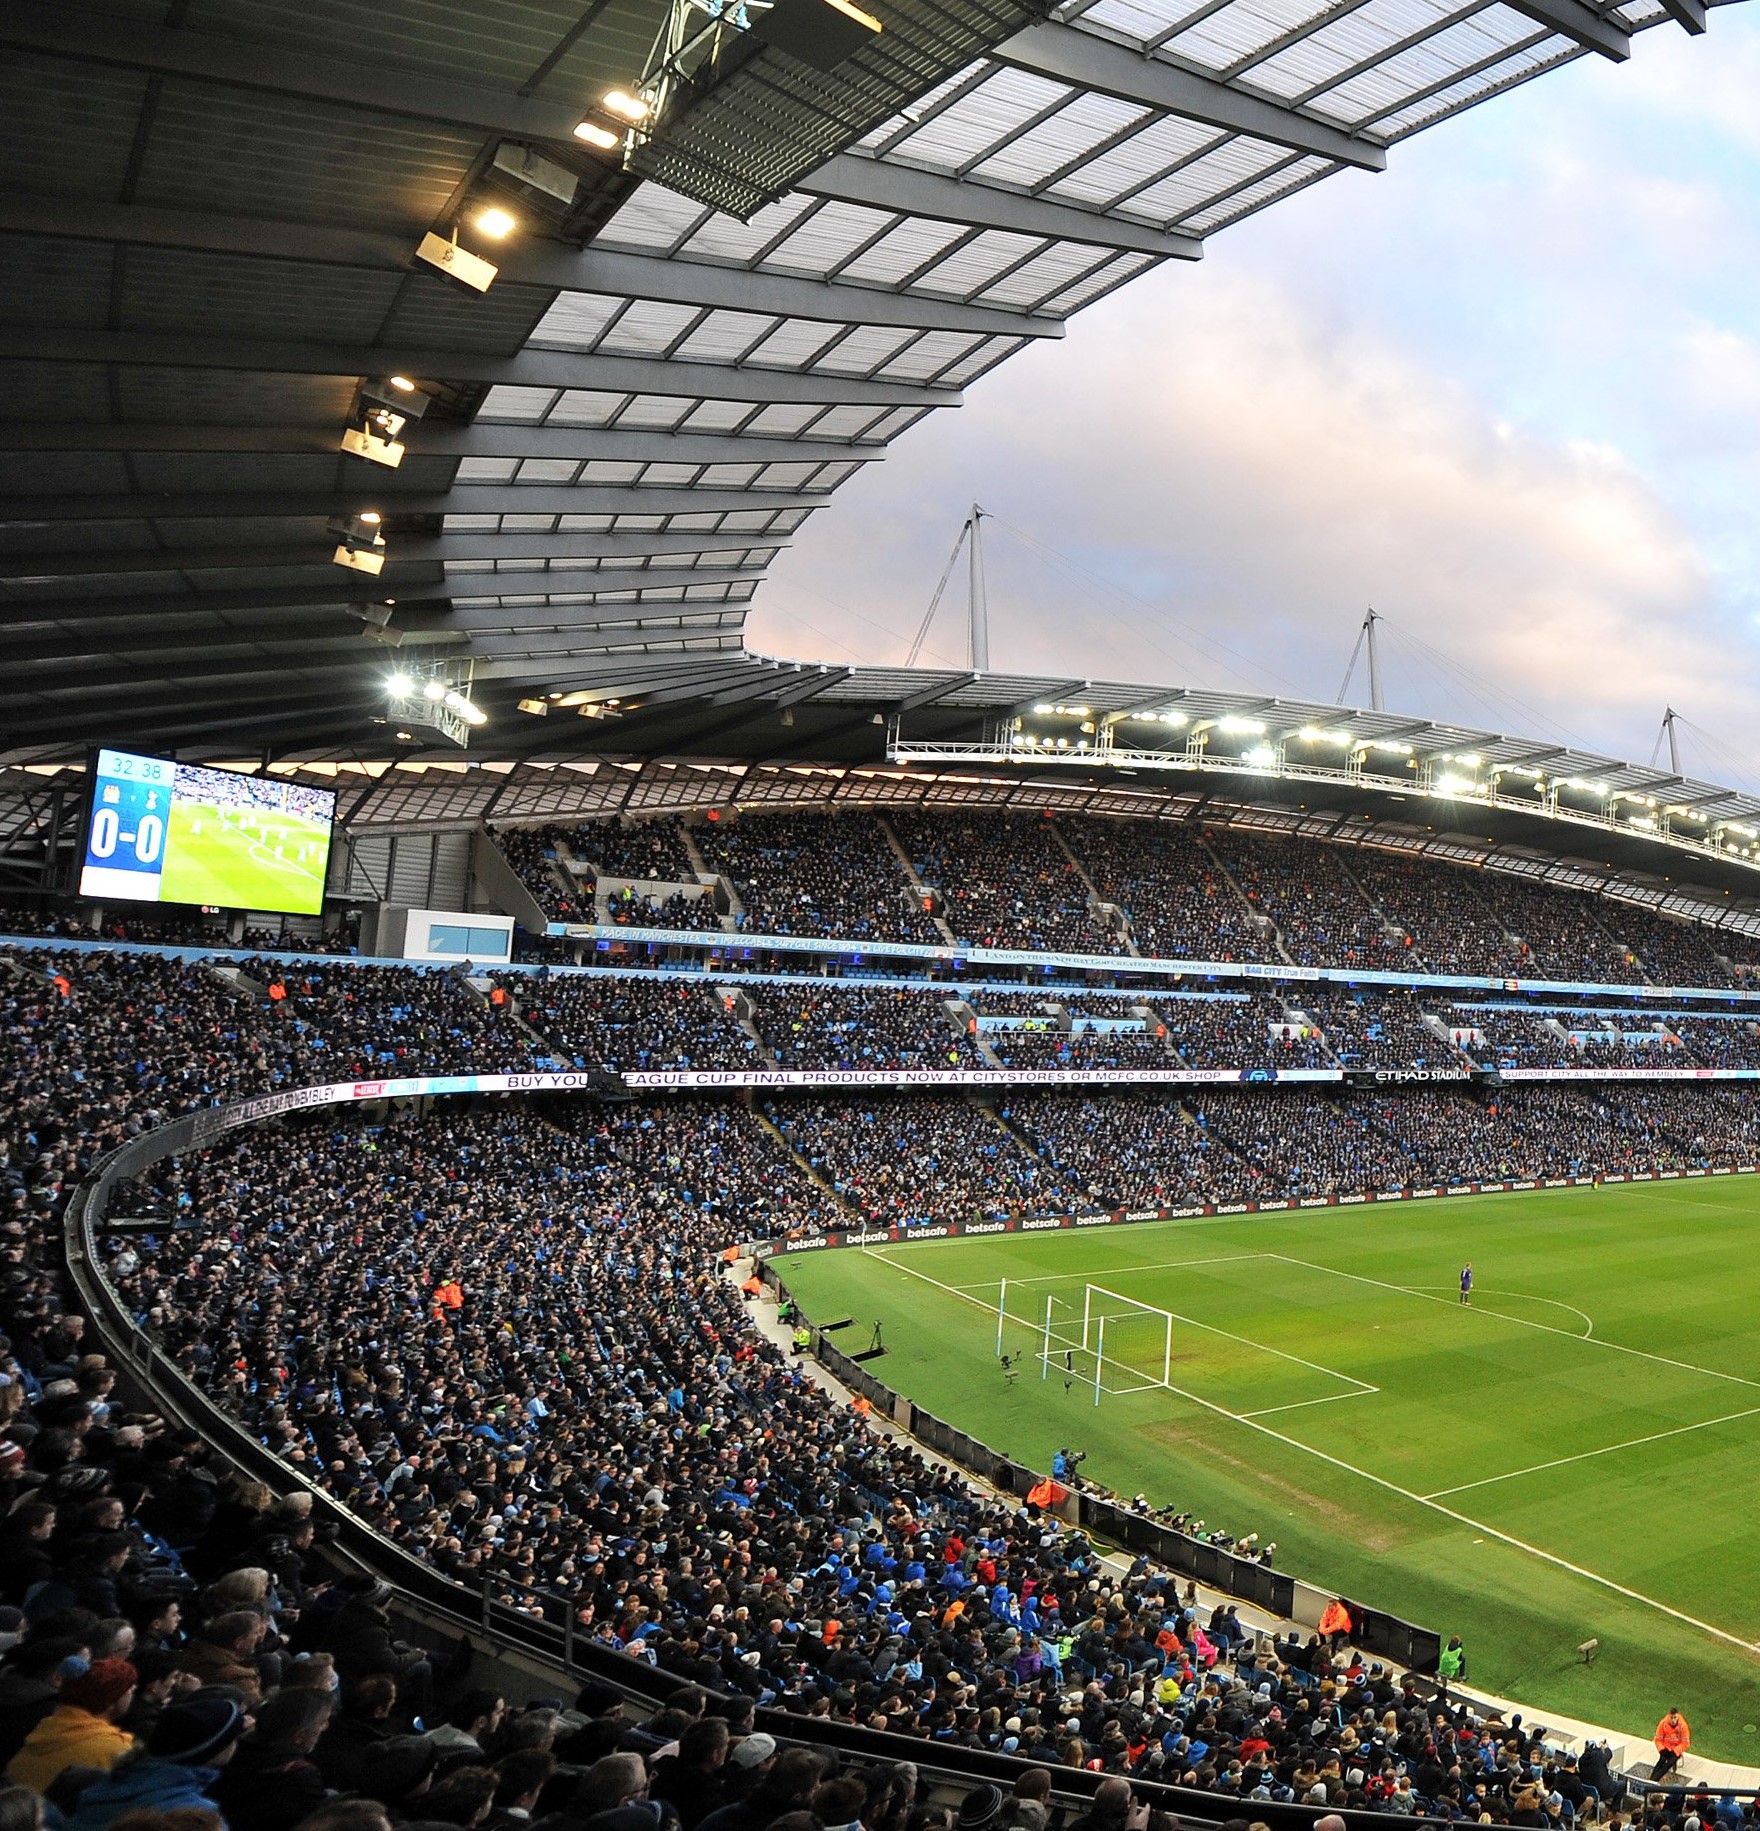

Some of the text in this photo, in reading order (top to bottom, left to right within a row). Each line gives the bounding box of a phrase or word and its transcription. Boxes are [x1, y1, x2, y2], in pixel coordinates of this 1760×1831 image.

[696, 1073, 736, 1084] CUP
[743, 1073, 796, 1083] FINAL
[803, 1072, 899, 1083] PRODUCTS
[906, 1072, 944, 1082] NOW
[949, 1072, 966, 1082] AT
[973, 1072, 1065, 1082] CITYSTORES
[1070, 1072, 1090, 1081] OR
[1375, 1071, 1471, 1080] ETIHAD STADIUM
[508, 1076, 543, 1088] BUY
[1300, 1196, 1328, 1207] betsafe
[1339, 1194, 1365, 1204] betsafe
[1377, 1191, 1402, 1201] betsafe
[1217, 1203, 1247, 1214] betsafe
[1260, 1200, 1288, 1210] betsafe
[1076, 1213, 1111, 1225] betsafe
[1126, 1209, 1158, 1221] betsafe
[965, 1221, 1005, 1233] betsafe
[1023, 1217, 1060, 1229] betsafe
[847, 1231, 888, 1244] betsafe
[907, 1226, 947, 1238] betsafe
[787, 1236, 826, 1251] betsafe
